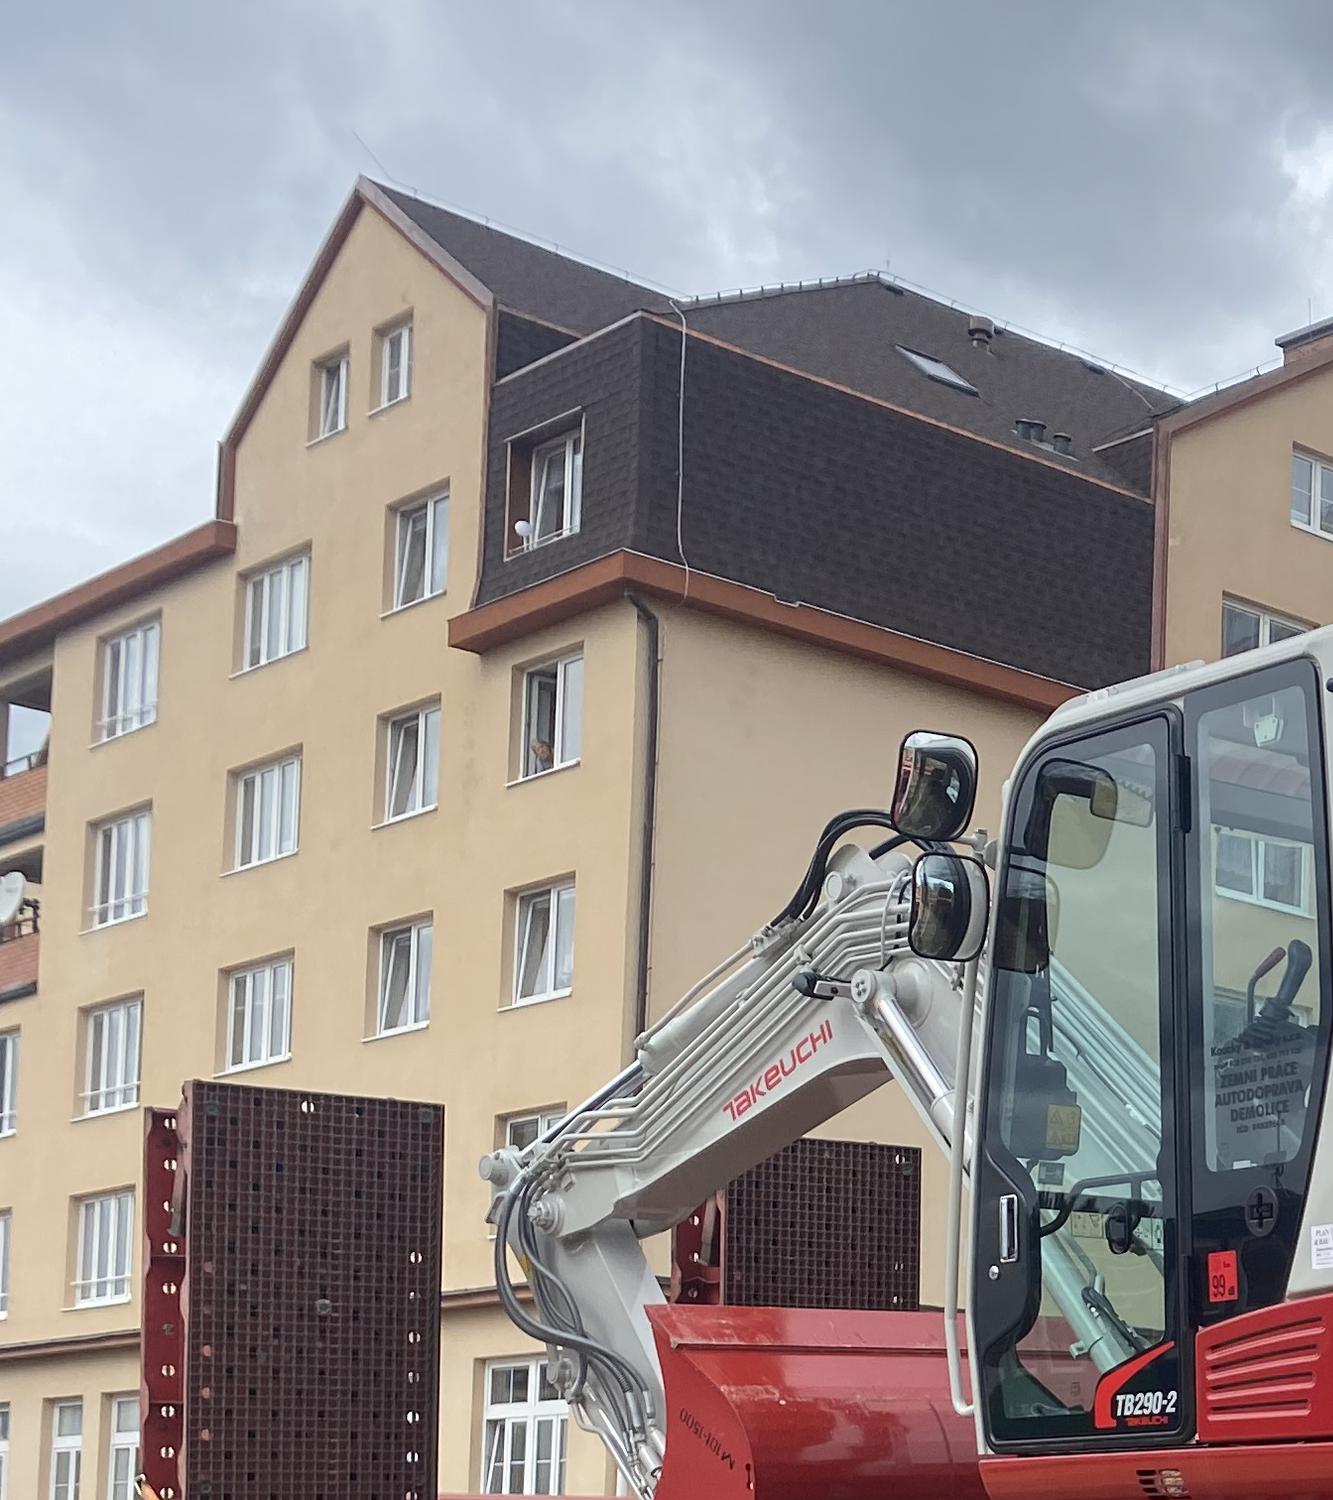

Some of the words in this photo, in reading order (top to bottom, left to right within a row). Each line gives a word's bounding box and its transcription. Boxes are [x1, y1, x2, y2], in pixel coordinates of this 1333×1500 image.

[1214, 1078, 1304, 1108] AUTODOPRAVA
[1230, 1099, 1290, 1122] DEMOLICE
[1212, 1274, 1226, 1298] 99
[1116, 1390, 1178, 1417] TB290-2
